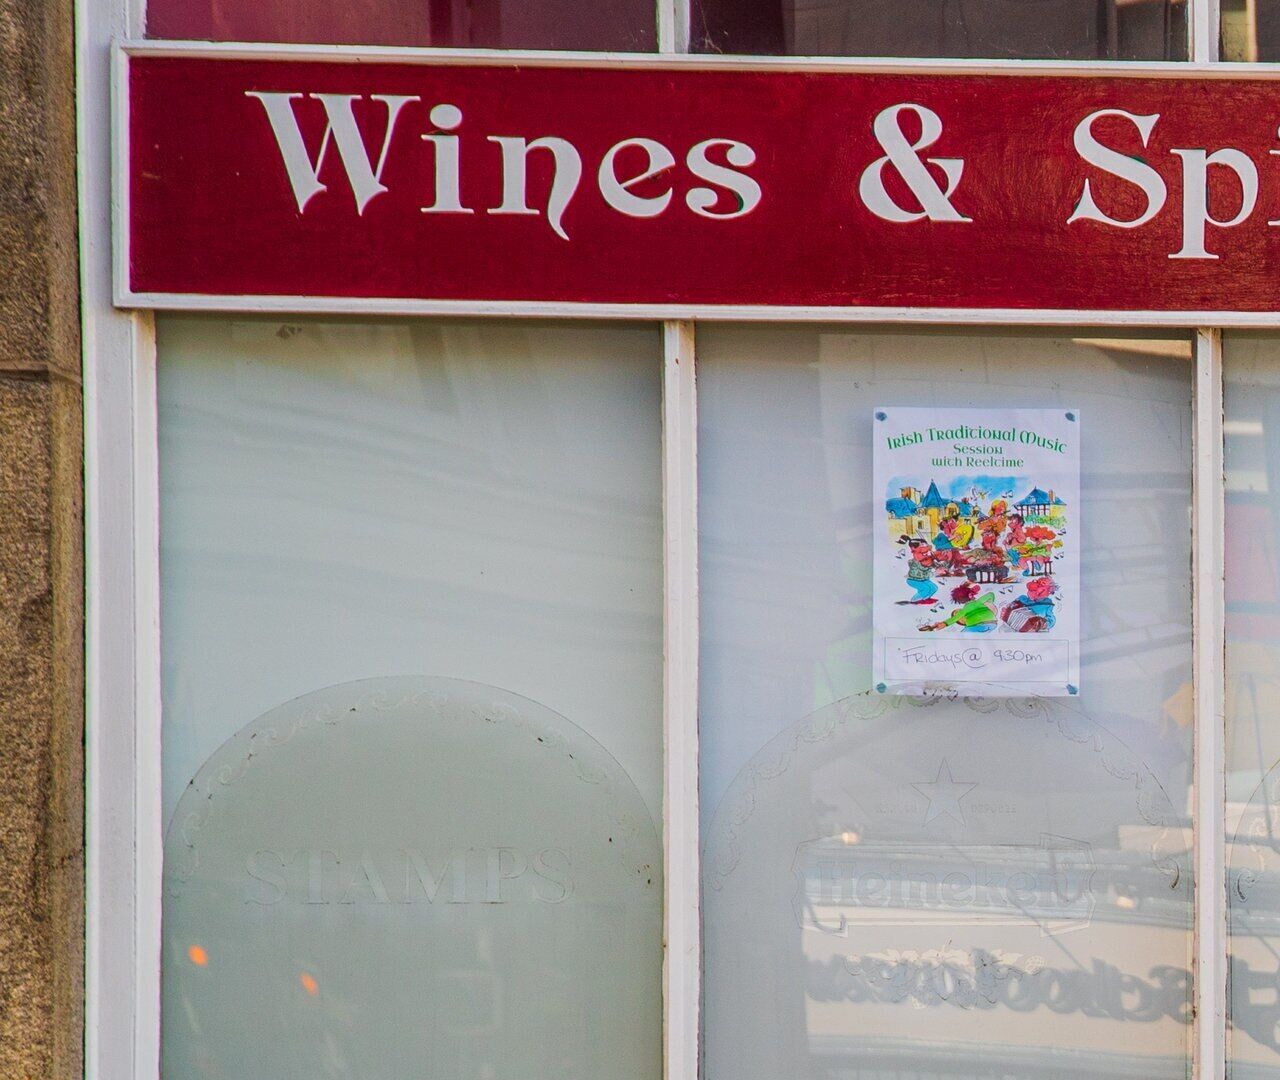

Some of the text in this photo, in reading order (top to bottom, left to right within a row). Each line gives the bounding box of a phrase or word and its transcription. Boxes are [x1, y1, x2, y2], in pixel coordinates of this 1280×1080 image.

[245, 91, 762, 241] Wines
[859, 102, 973, 223] &
[886, 425, 1067, 454] Irish Traditional Music
[953, 443, 1003, 455] Session
[932, 456, 963, 467] with
[244, 846, 575, 905] STAMPS
[816, 859, 1085, 908] Heineken
